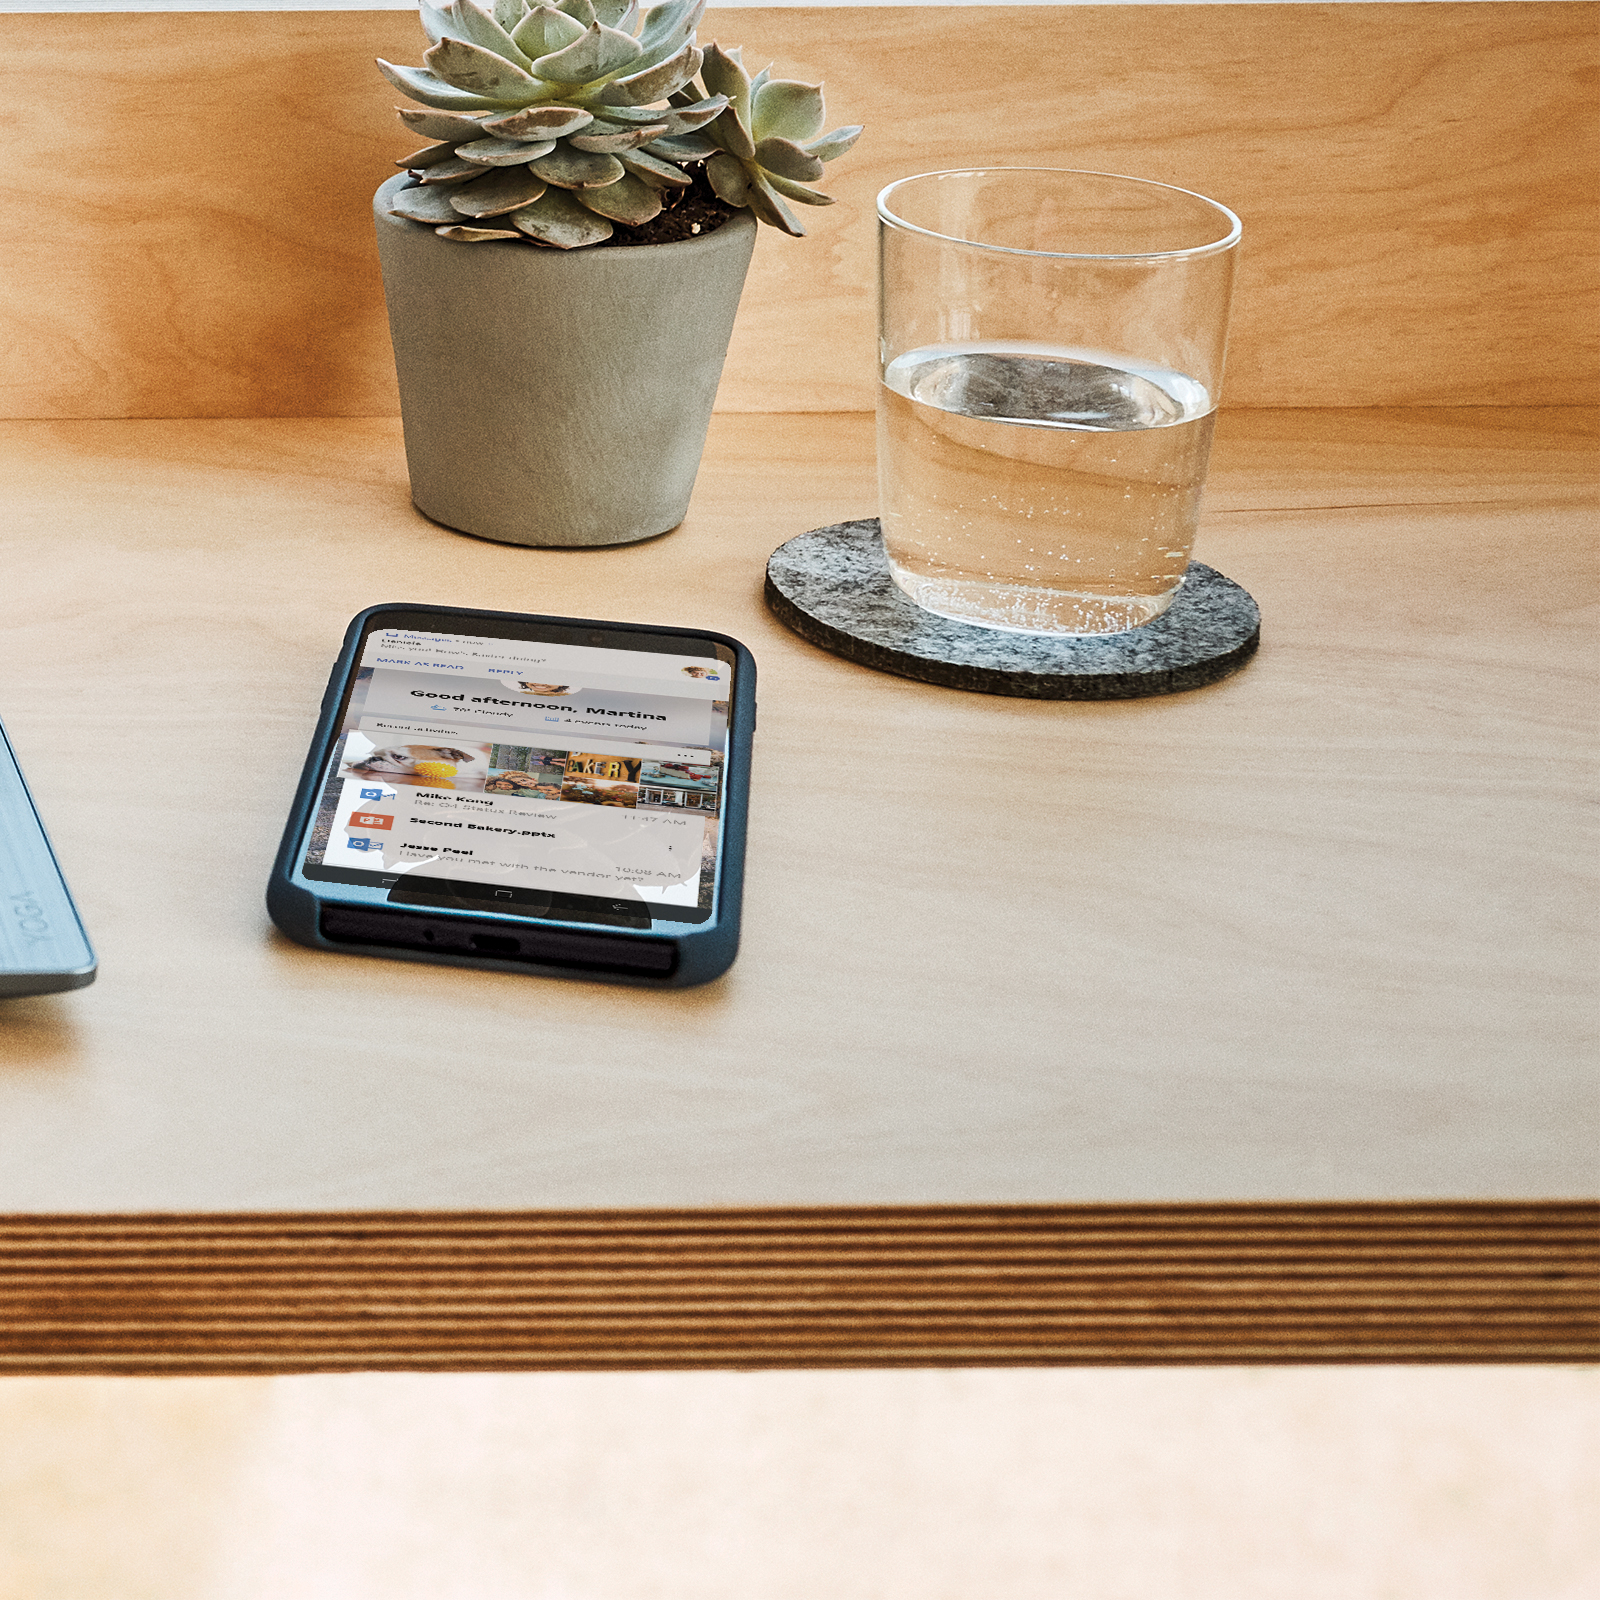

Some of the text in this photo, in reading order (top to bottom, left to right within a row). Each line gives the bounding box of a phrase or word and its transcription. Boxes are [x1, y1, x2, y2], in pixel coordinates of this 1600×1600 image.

[410, 689, 465, 702] Good
[471, 694, 578, 714] afternoon,
[586, 706, 667, 721] Martina
[566, 758, 642, 783] BAKERY
[409, 817, 556, 839] Second Bakery.pptx
